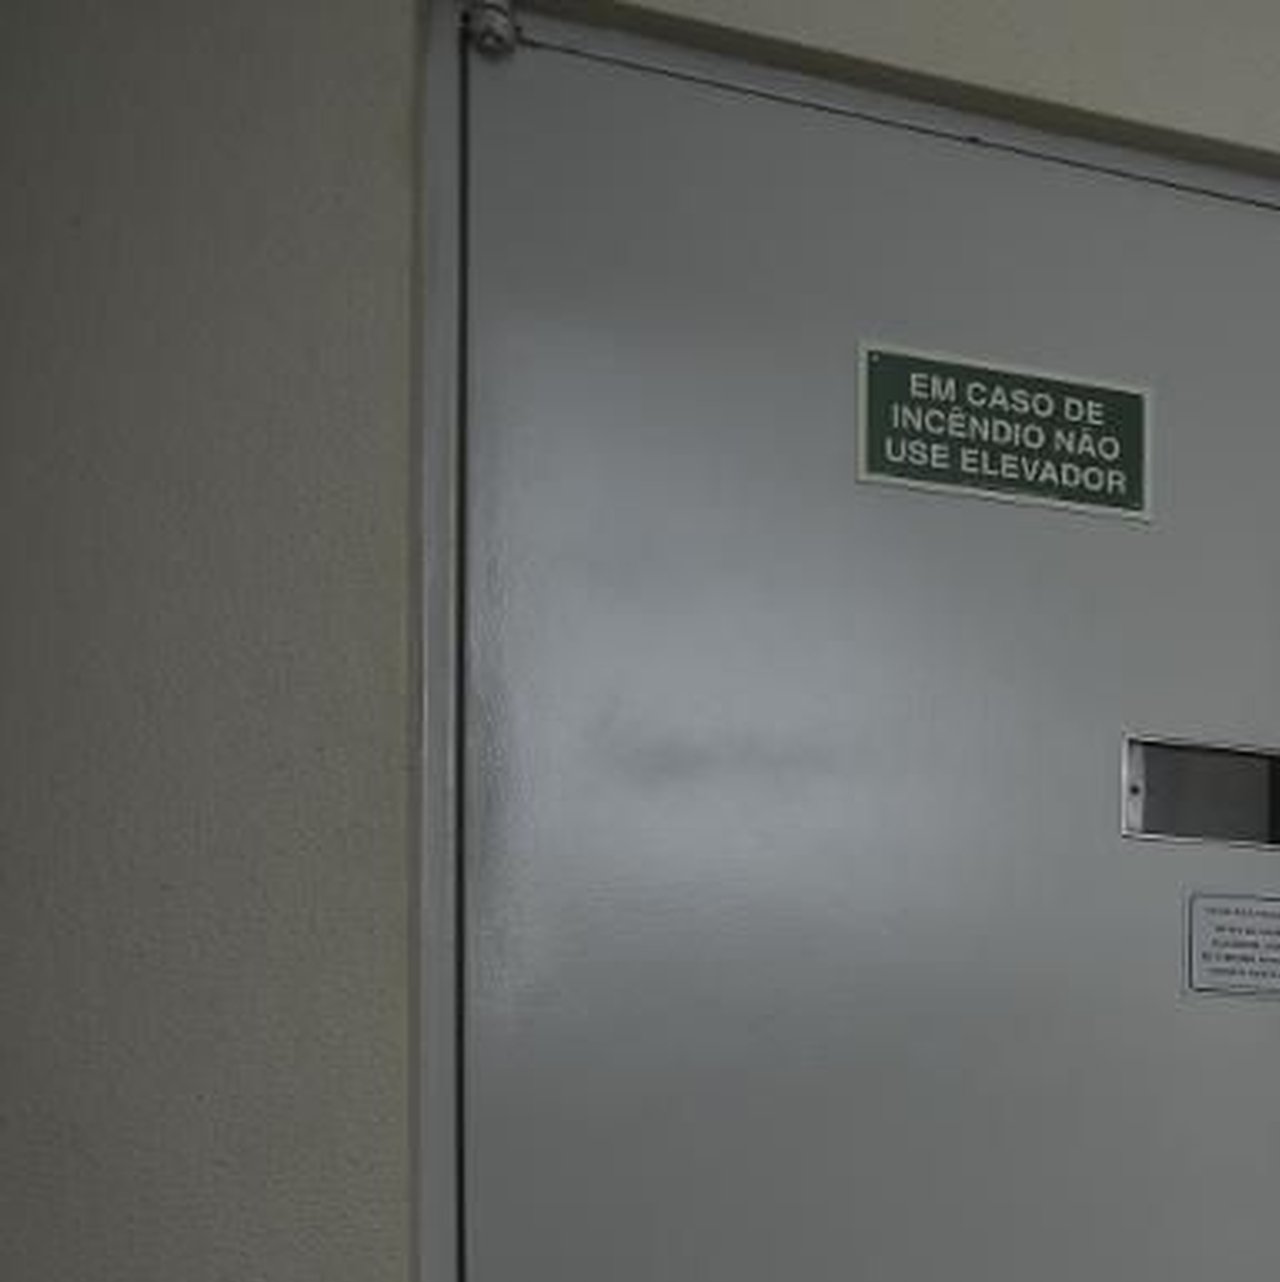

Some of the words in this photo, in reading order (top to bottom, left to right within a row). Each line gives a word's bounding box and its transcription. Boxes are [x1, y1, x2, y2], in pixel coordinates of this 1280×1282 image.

[910, 373, 955, 402] EM
[967, 383, 1053, 417] CASO
[1064, 399, 1105, 425] DE
[892, 403, 1045, 449] INCÊNDIO
[1054, 425, 1120, 460] NÃO
[884, 437, 950, 468] USE
[961, 449, 1126, 493] ELEVADOR
